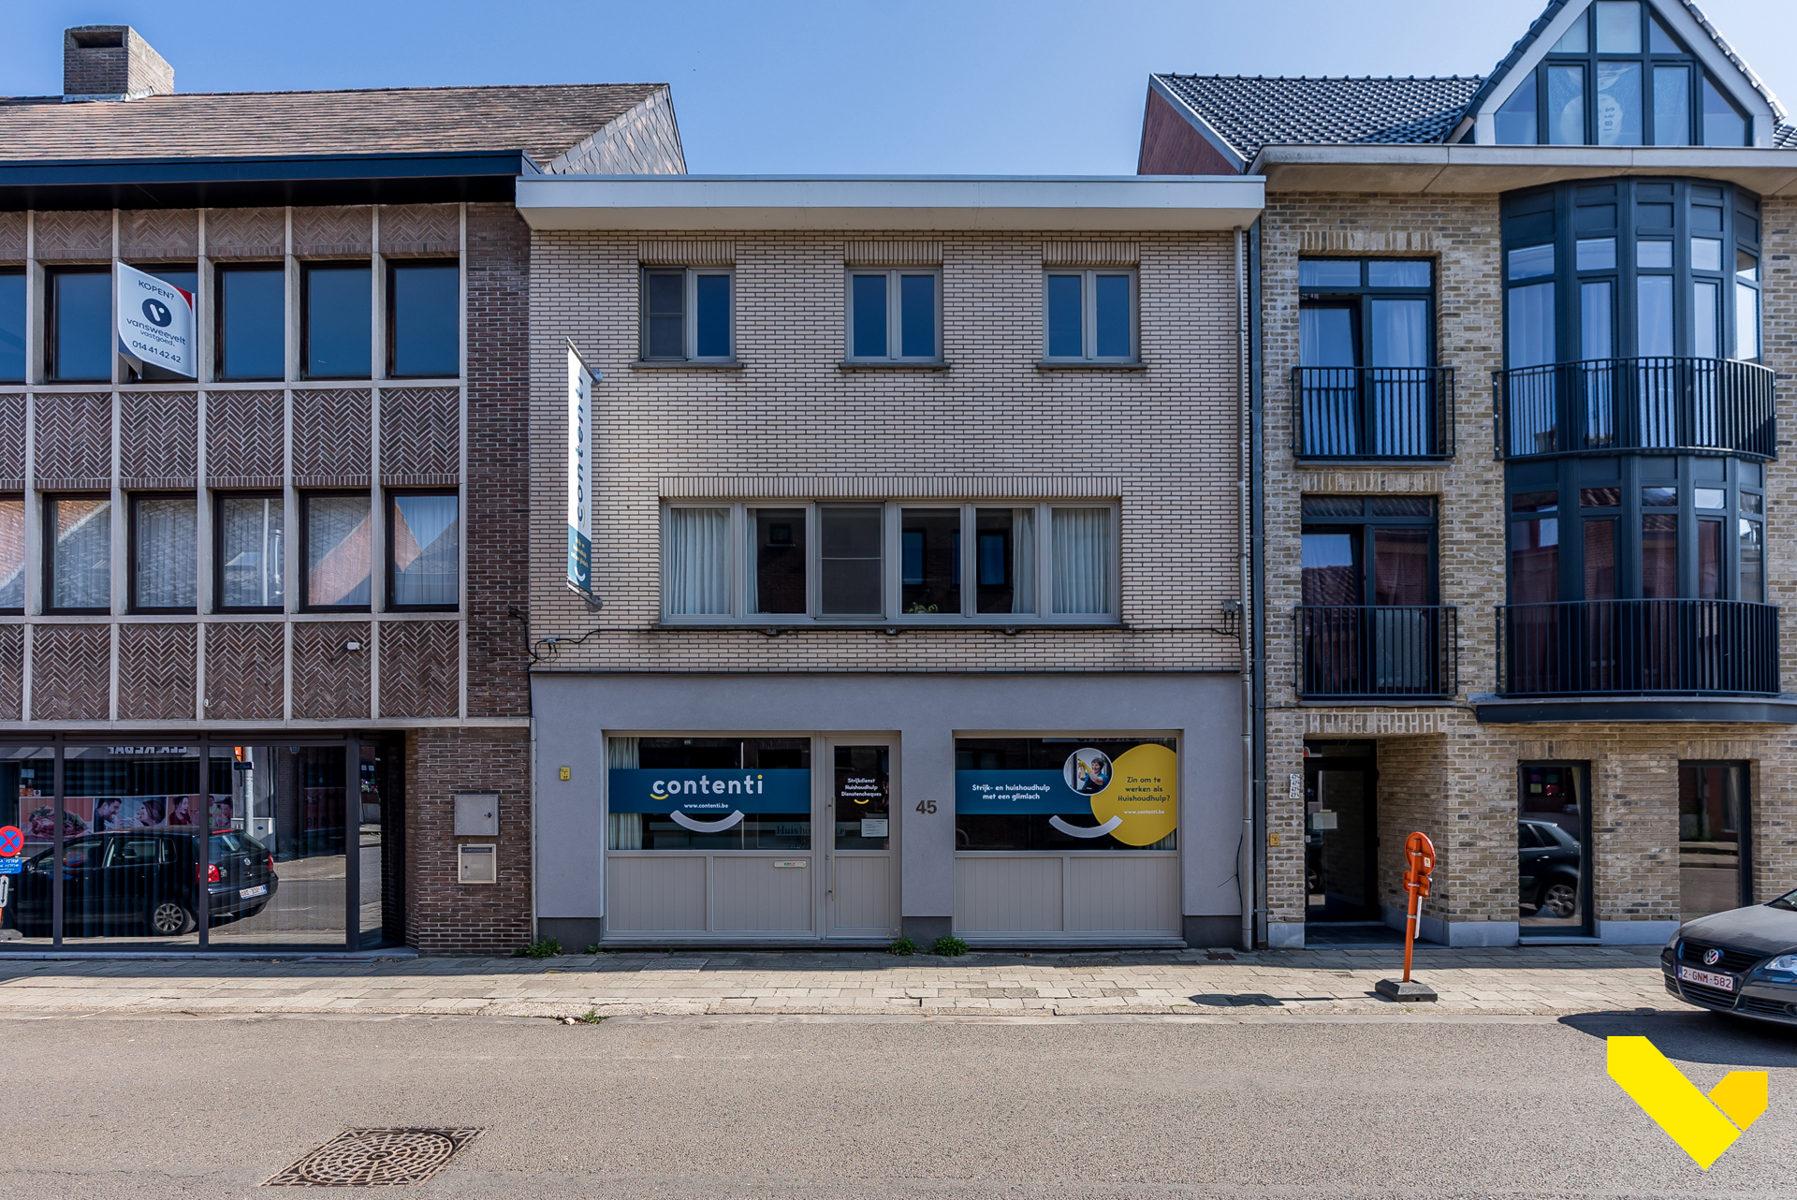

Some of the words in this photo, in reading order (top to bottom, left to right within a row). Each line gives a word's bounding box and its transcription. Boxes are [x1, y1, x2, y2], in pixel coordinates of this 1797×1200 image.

[138, 280, 175, 300] KOPEN?
[126, 317, 186, 345] vansweevelt
[132, 340, 147, 351] 014
[148, 345, 158, 355] 41
[159, 348, 170, 359] 42
[171, 353, 181, 363] 42
[652, 774, 763, 795] contenti
[972, 784, 993, 792] Strijk-
[1005, 784, 1050, 792] huishoudhulp
[915, 800, 937, 814] 45
[1012, 793, 1040, 802] glimlach
[1117, 795, 1170, 803] Huishoudhulp?
[1683, 969, 1732, 989] 2-GNM-582
